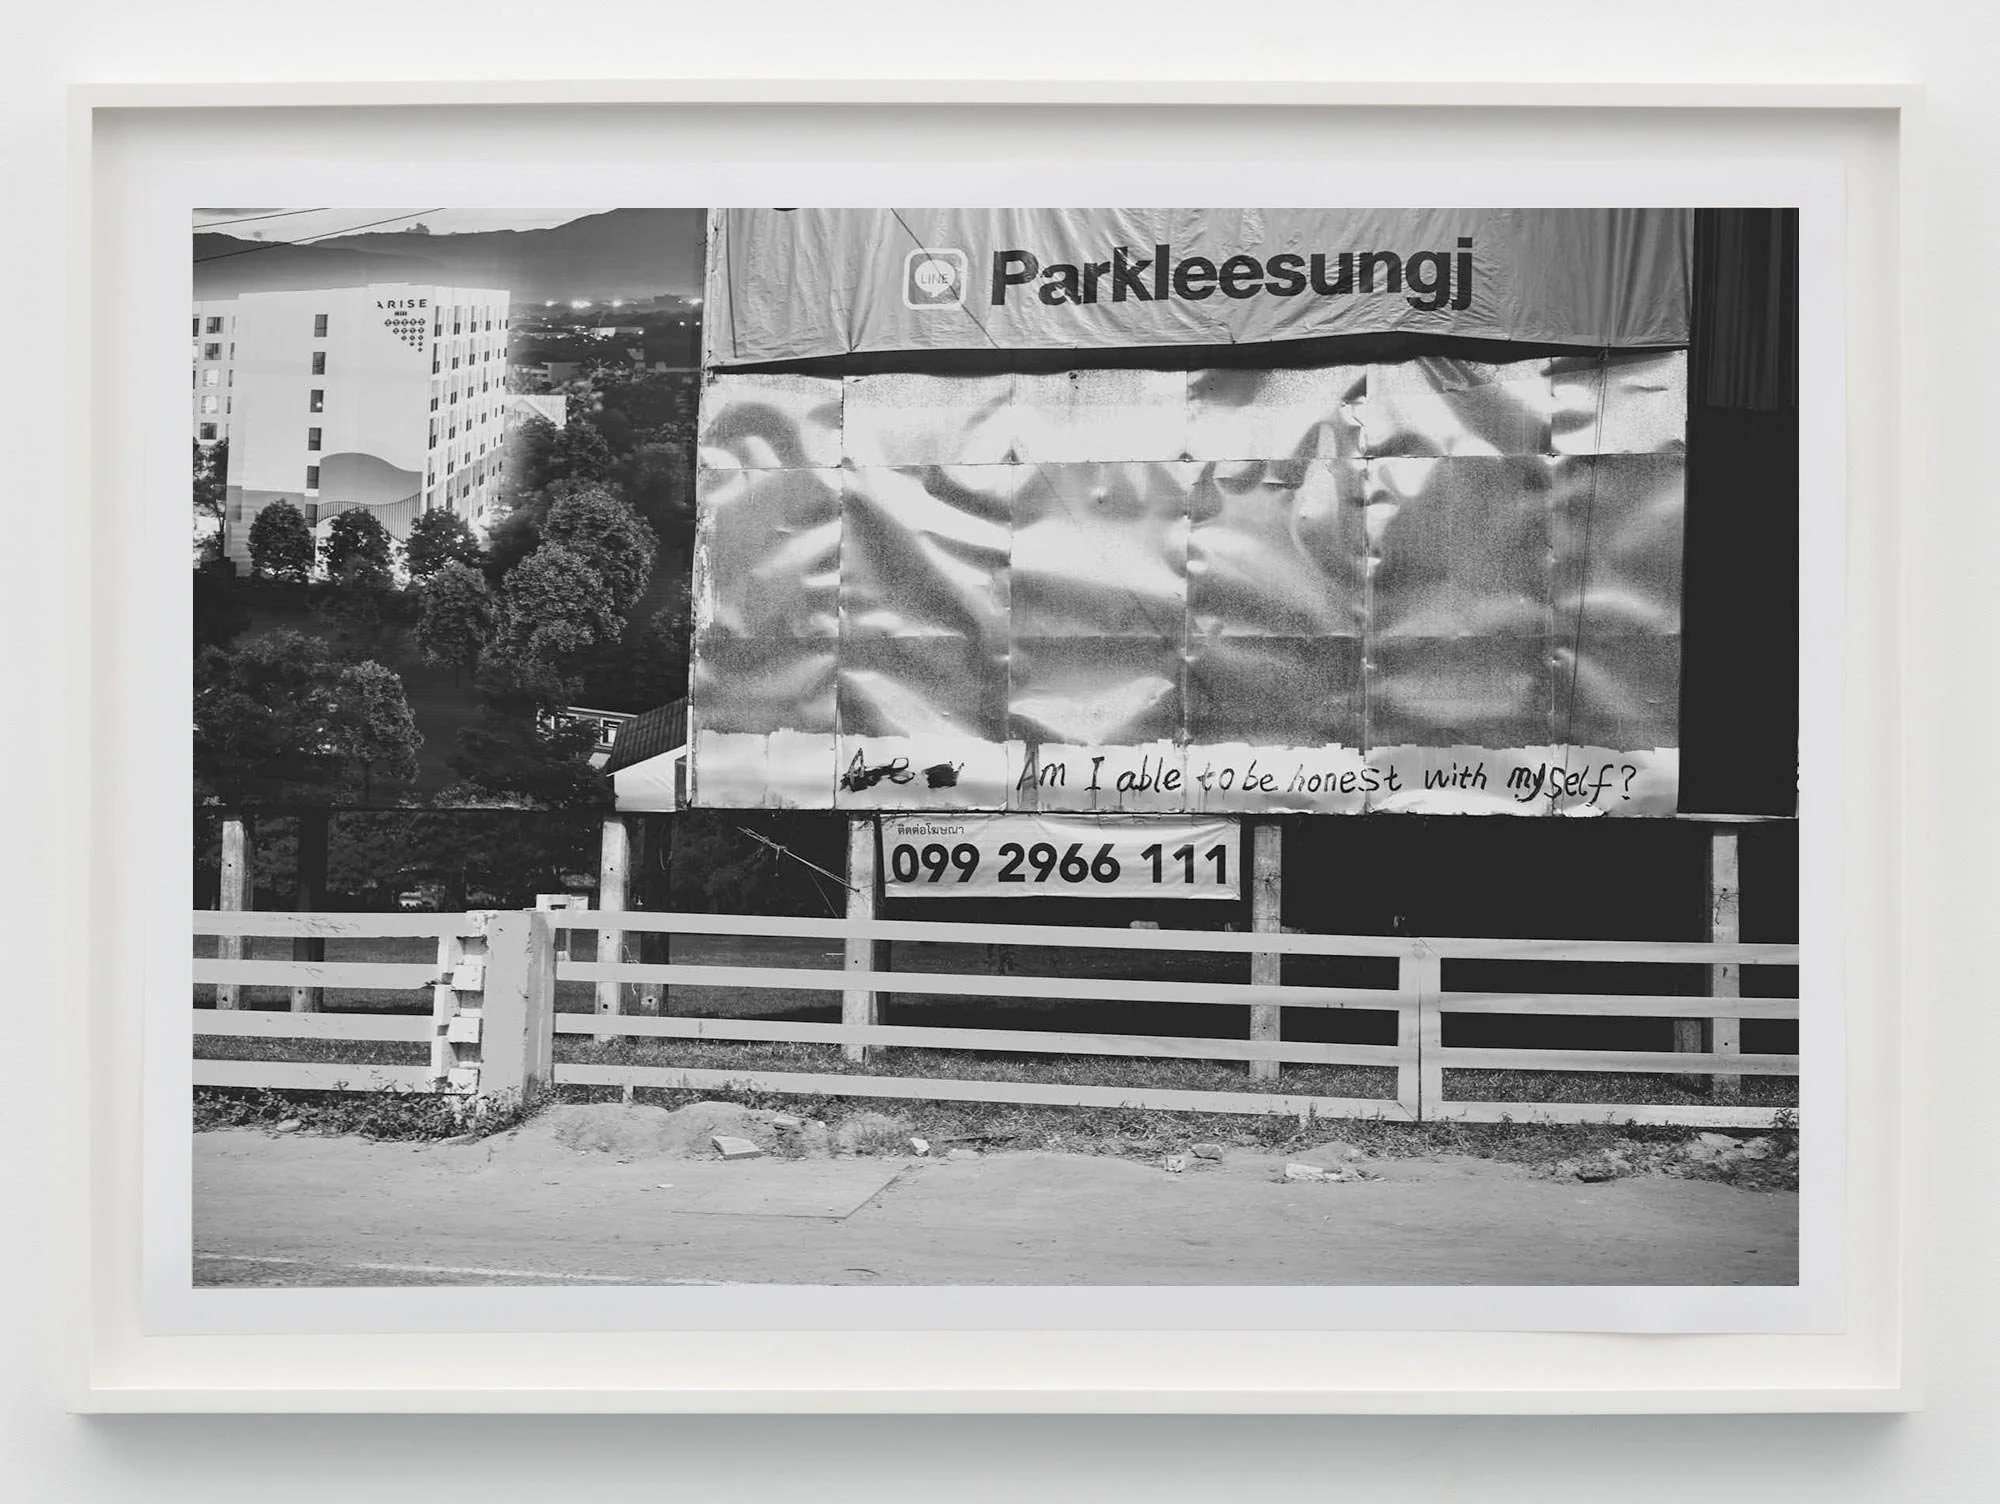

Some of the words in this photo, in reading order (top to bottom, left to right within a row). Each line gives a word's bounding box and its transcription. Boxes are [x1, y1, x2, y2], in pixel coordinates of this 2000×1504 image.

[991, 237, 1473, 312] Parkleesungj
[376, 299, 427, 309] ARISE
[1016, 751, 1066, 792] Am
[1084, 756, 1105, 791] I
[1116, 755, 1182, 793] able
[1286, 764, 1402, 793] honest
[1424, 762, 1488, 790] with
[1506, 763, 1637, 807] myself?
[897, 823, 965, 835] ติดต่อโฆษณา
[892, 842, 980, 883] 099
[998, 842, 1121, 883] 2966
[1140, 843, 1227, 885] 111
